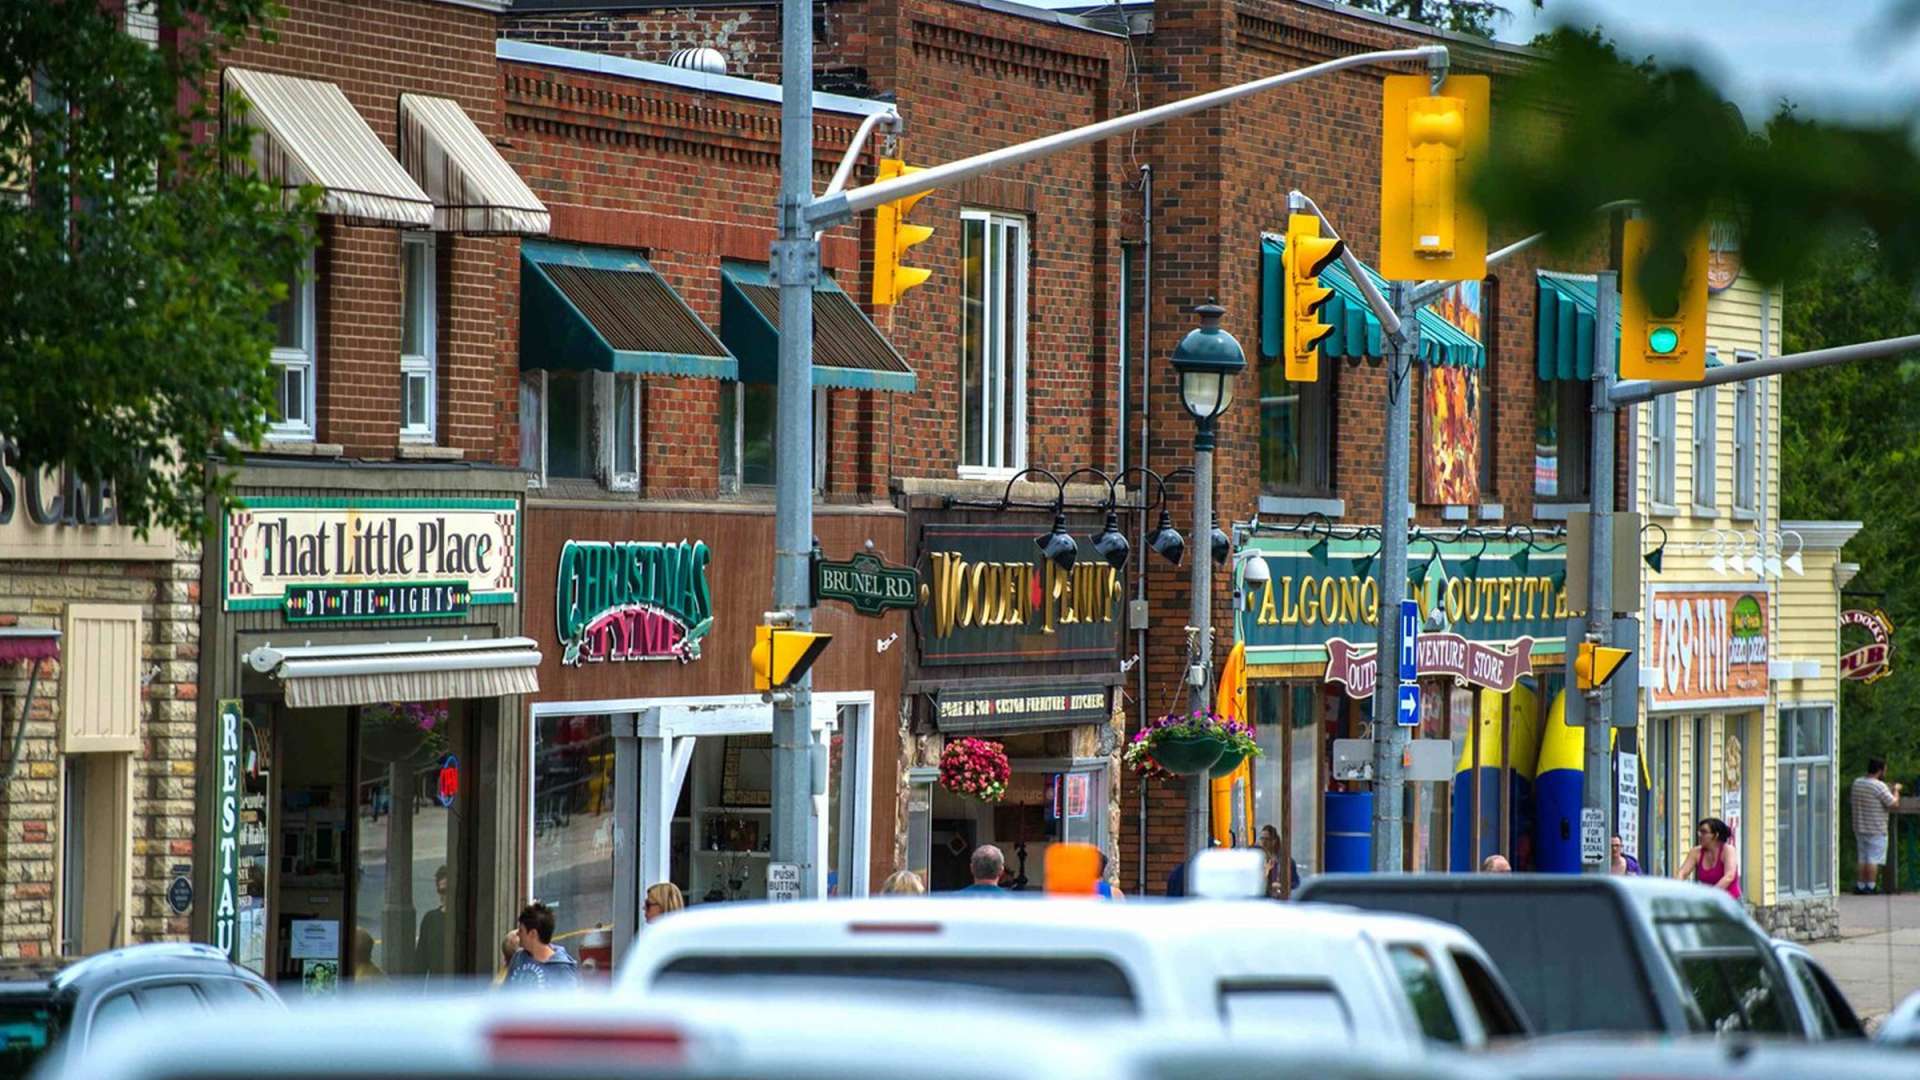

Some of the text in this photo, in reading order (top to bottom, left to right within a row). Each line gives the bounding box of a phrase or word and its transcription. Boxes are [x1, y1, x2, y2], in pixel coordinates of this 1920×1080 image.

[258, 517, 492, 577] That Little Place
[558, 540, 711, 643] CHRISTMAS
[823, 570, 914, 598] BRUNEL RD.
[1256, 575, 1587, 624] ALGONQN OUTFITTE
[306, 586, 454, 615] BY THE LIGHTS
[1473, 651, 1505, 684] STORE
[769, 881, 801, 890] BUTTON
[774, 870, 795, 880] PUSH
